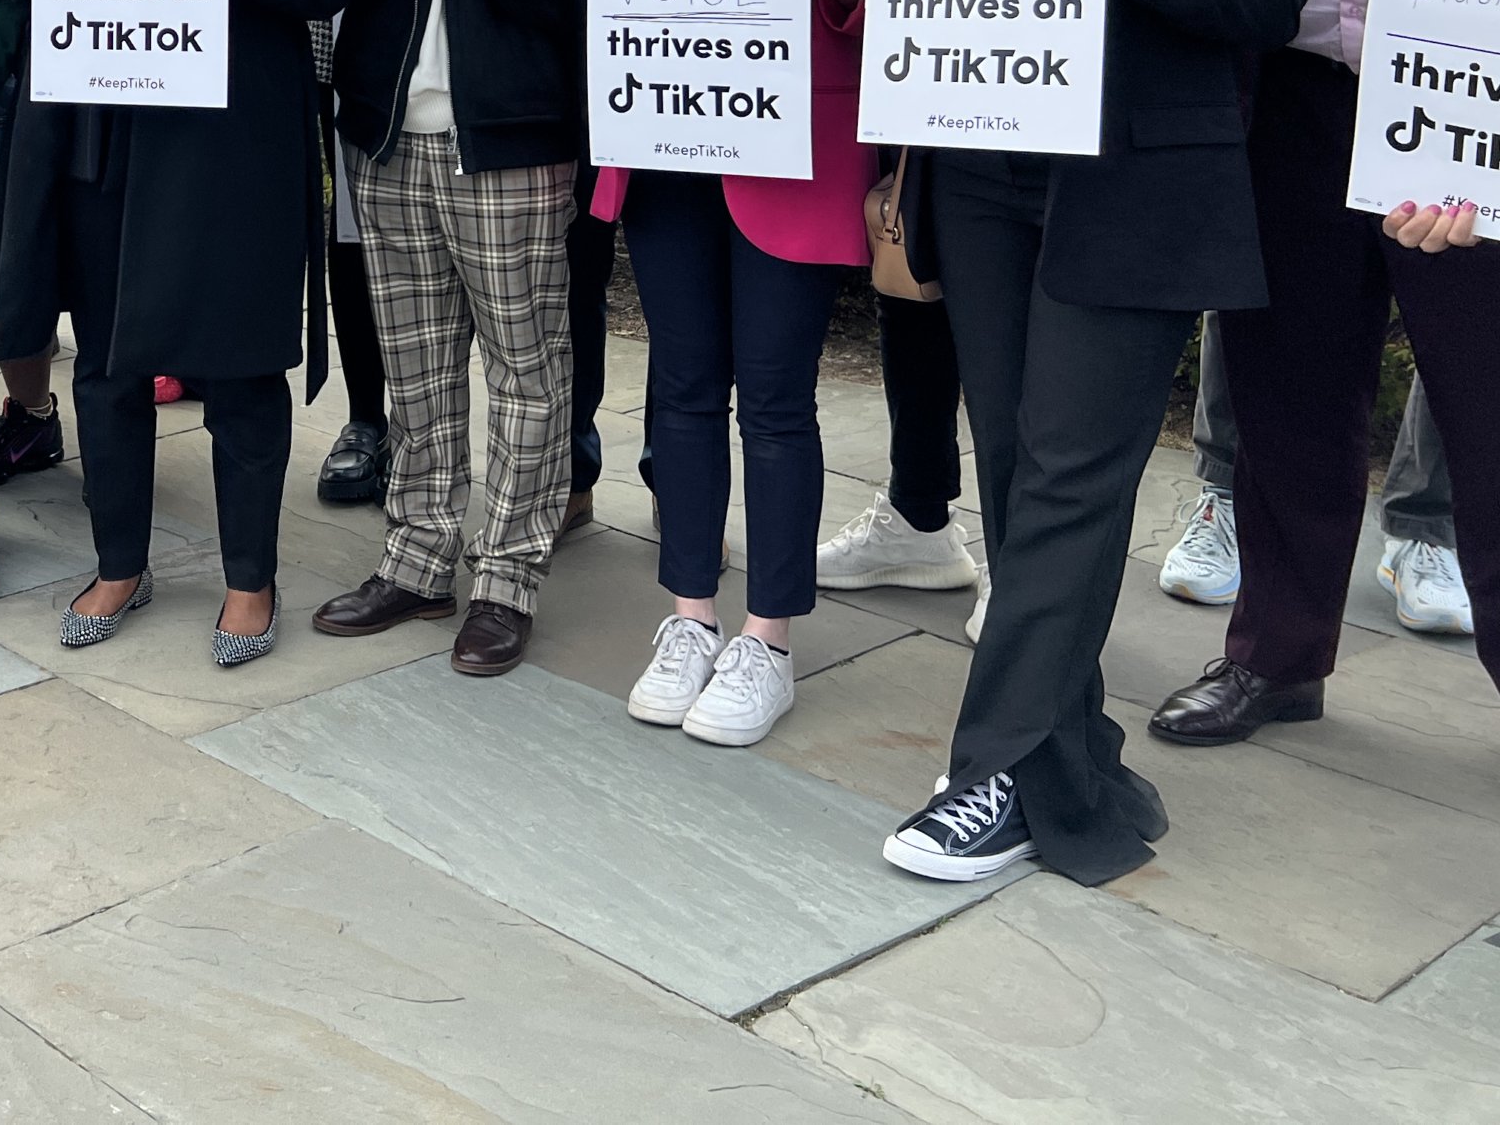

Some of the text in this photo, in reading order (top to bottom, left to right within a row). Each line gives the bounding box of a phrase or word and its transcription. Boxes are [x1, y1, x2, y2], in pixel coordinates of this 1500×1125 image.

[87, 21, 203, 53] TikTok
[607, 27, 790, 61] thrives on
[927, 48, 1070, 86] TikTok
[88, 76, 165, 91] #KeepTikTok
[649, 83, 781, 120] TikTok
[926, 115, 1021, 133] #KeepTikTok
[653, 142, 741, 159] #KeepTikTok
